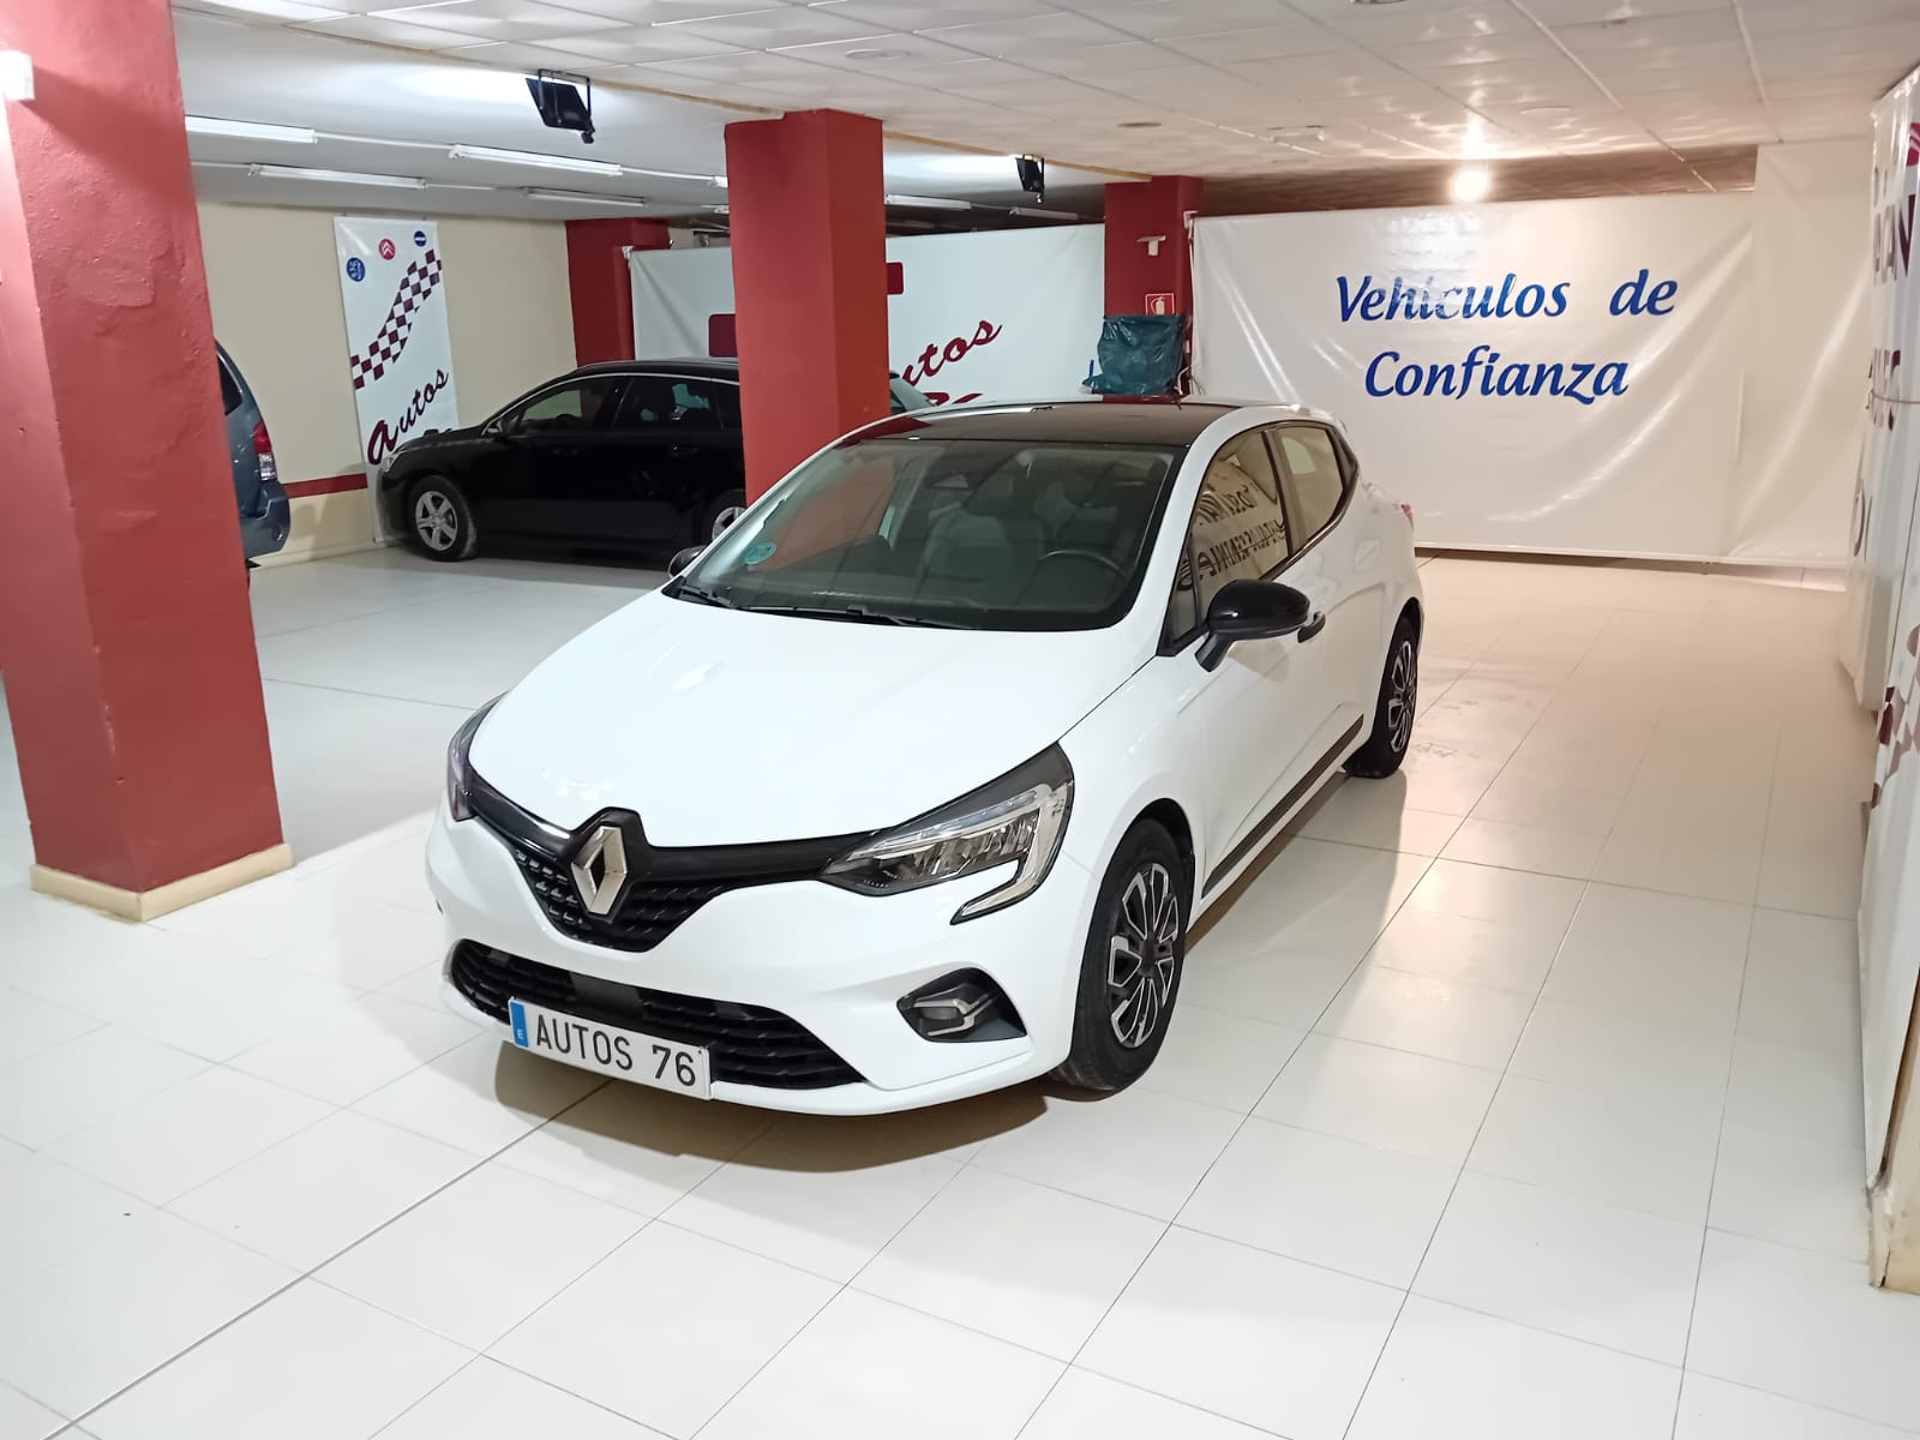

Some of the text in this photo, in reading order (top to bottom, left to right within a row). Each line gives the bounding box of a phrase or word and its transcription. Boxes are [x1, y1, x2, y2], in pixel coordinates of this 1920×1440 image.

[1609, 268, 1679, 316] de
[1365, 345, 1630, 405] Confianza
[536, 1014, 697, 1087] AUTOS 76
